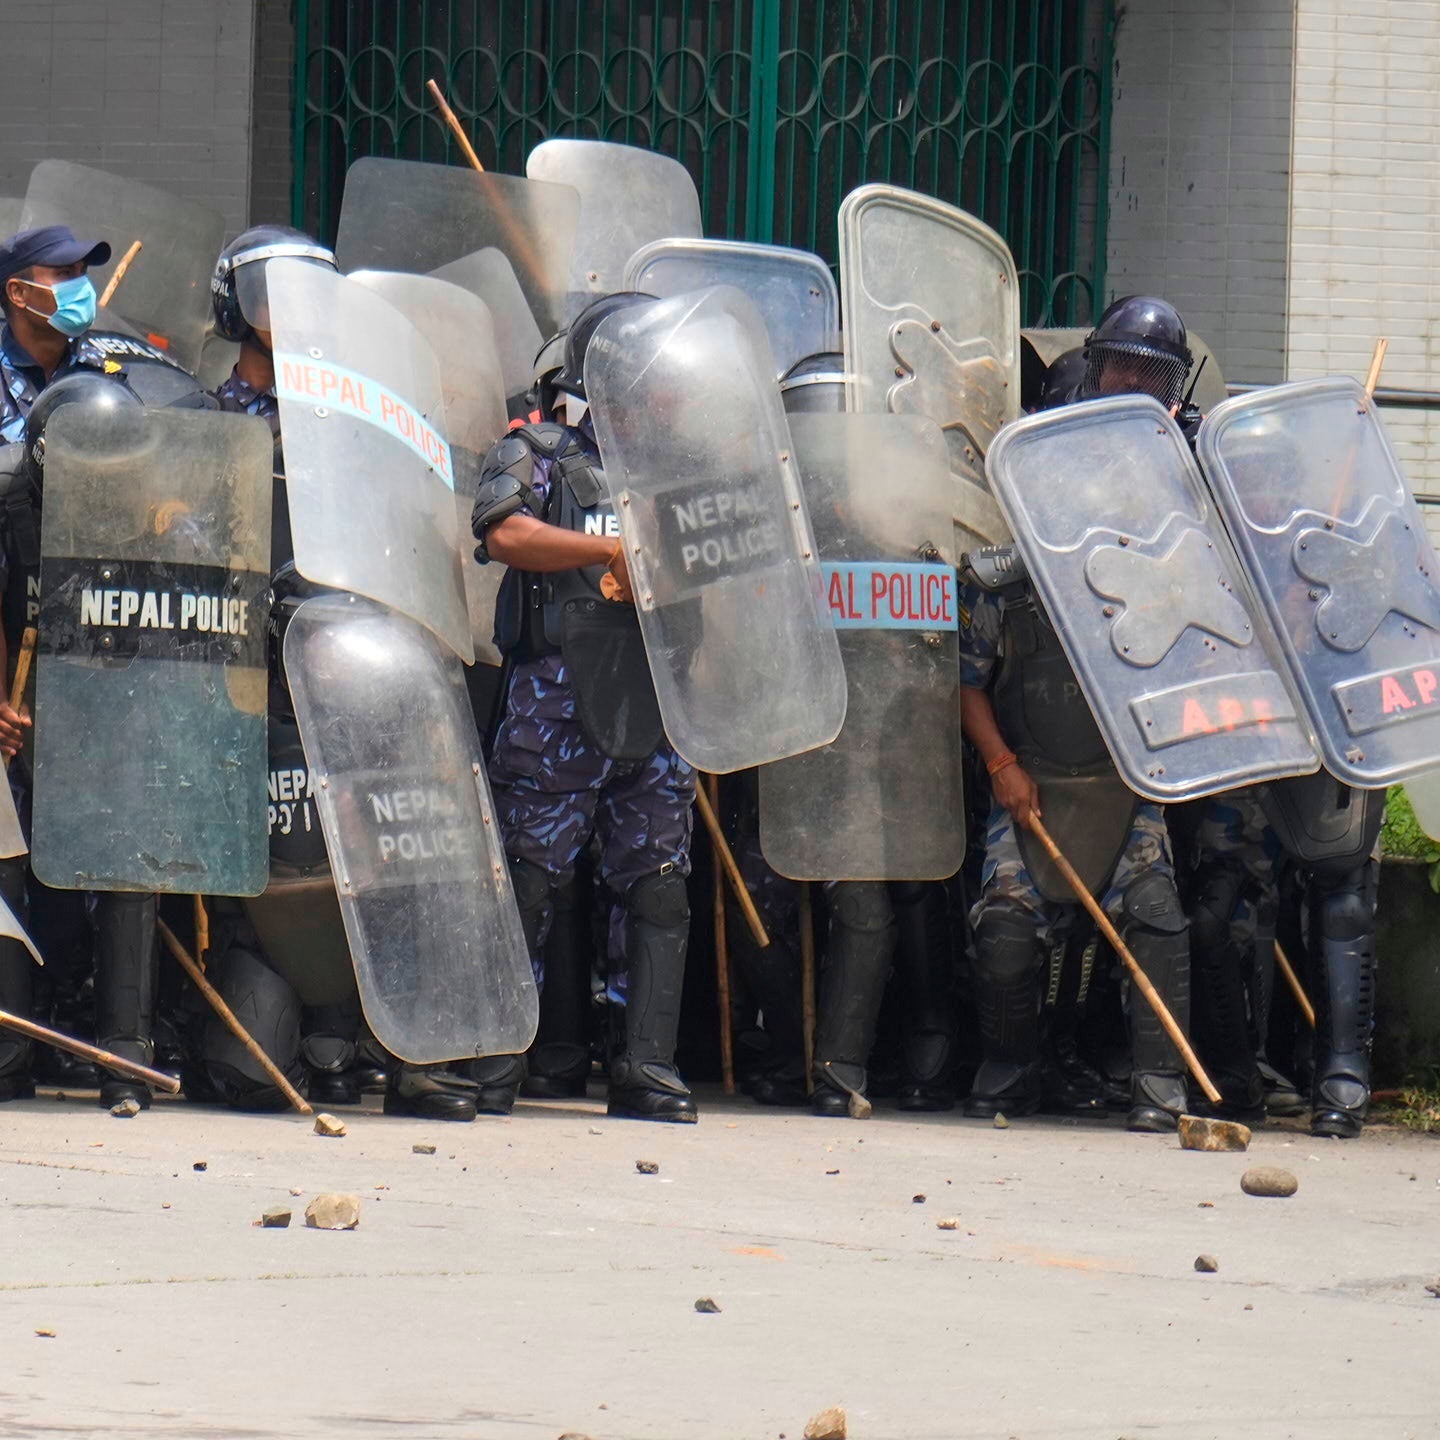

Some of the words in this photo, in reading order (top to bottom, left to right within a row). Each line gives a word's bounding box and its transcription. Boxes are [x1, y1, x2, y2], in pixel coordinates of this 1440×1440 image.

[282, 362, 372, 414] NEPAL
[379, 392, 450, 478] POLICE
[672, 480, 766, 534] NEPAL
[80, 589, 175, 630] NEPAL
[180, 593, 249, 636] POLICE
[871, 571, 953, 622] POLICE
[267, 767, 318, 802] NEPA
